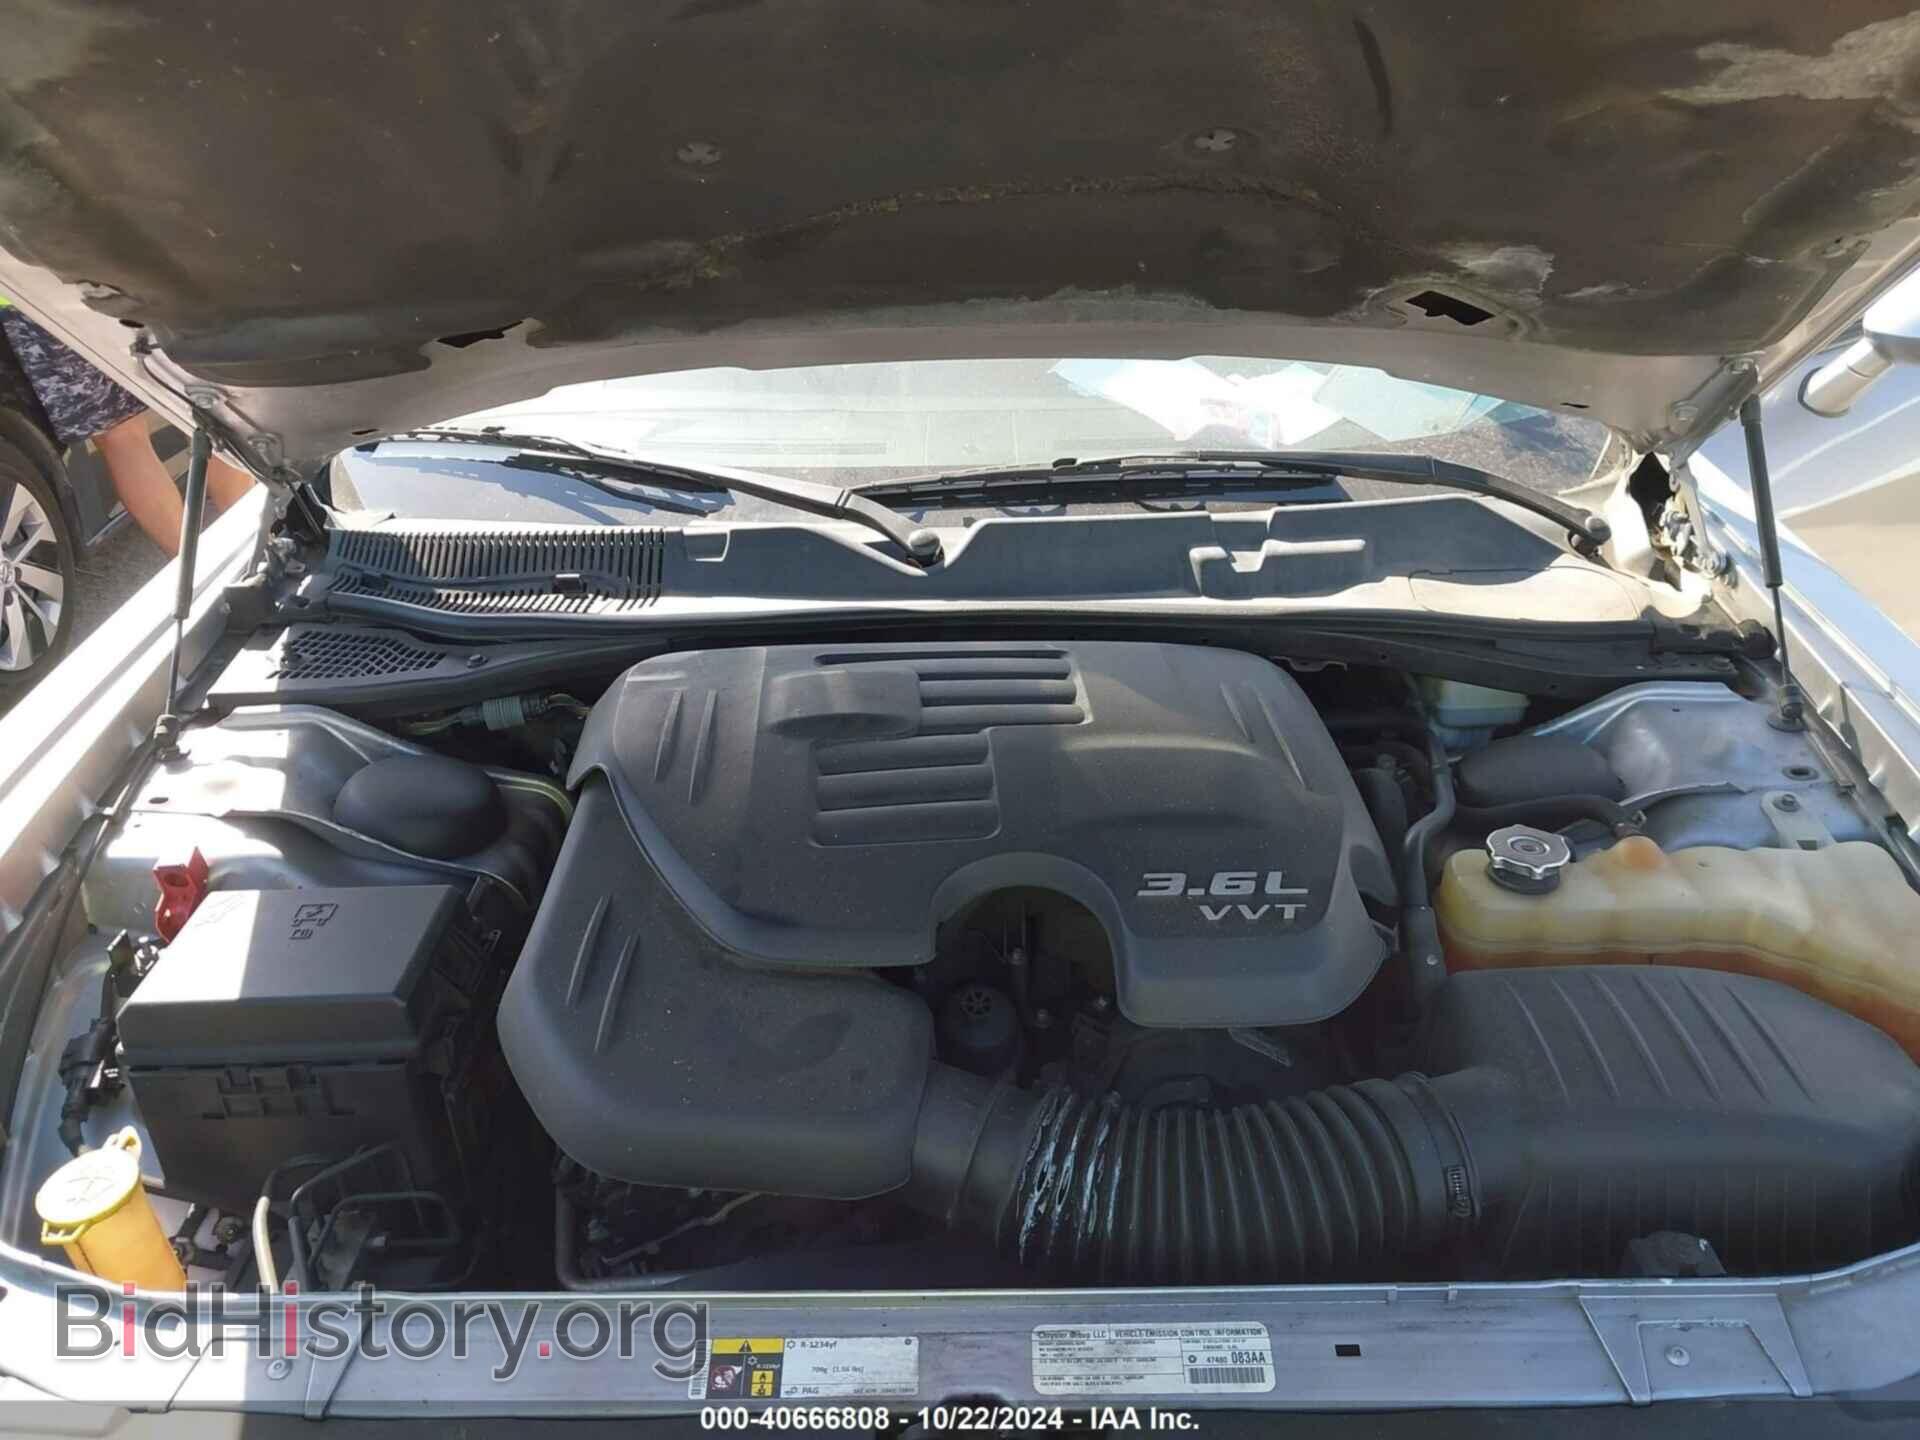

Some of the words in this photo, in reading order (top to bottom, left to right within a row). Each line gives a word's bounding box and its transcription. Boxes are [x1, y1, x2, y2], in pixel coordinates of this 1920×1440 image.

[1137, 871, 1309, 896] 3.6L
[1200, 904, 1307, 921] VVT
[1114, 1328, 1142, 1338] VEHICLE
[1145, 1328, 1178, 1337] EMISSION
[1180, 1328, 1210, 1337] CONTROL
[1214, 1327, 1262, 1336] INFORMATION
[1231, 1352, 1266, 1364] 083AA
[801, 1387, 820, 1395] PAG
